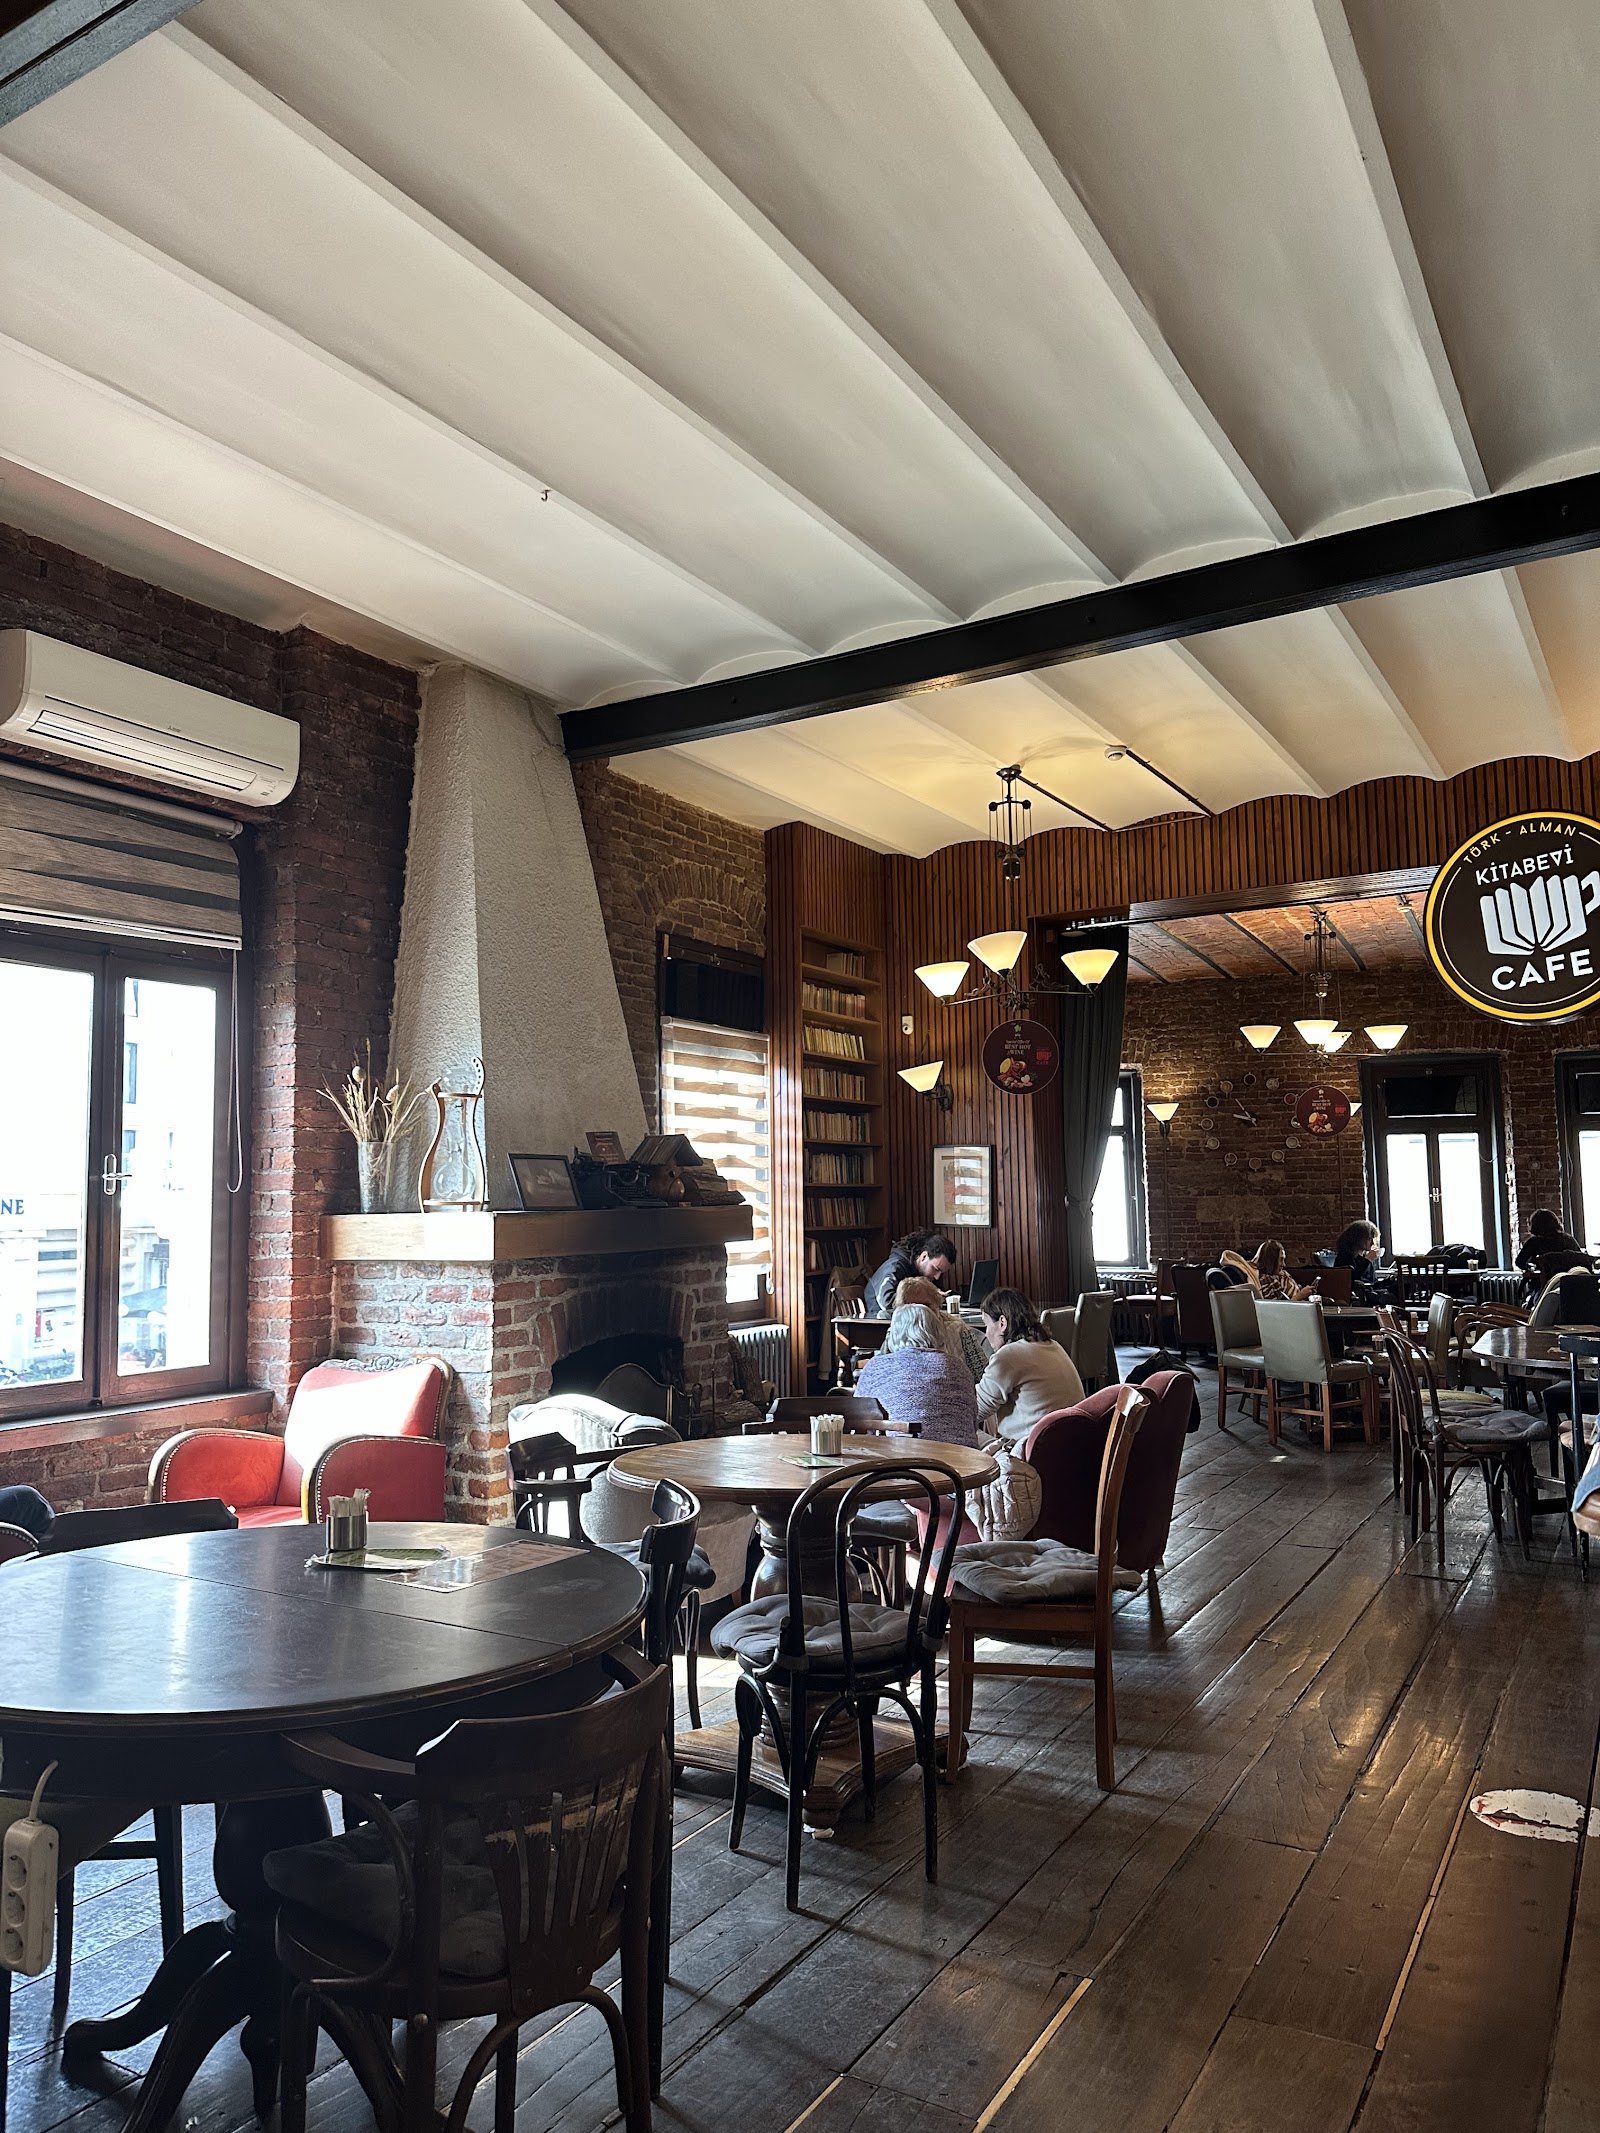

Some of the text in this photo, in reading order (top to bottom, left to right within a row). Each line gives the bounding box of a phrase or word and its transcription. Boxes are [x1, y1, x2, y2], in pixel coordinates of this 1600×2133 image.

[1519, 822, 1576, 837] ALMAN
[1475, 843, 1574, 886] KİTABEVİ
[1491, 948, 1594, 991] CAFE
[0, 1199, 24, 1215] NE
